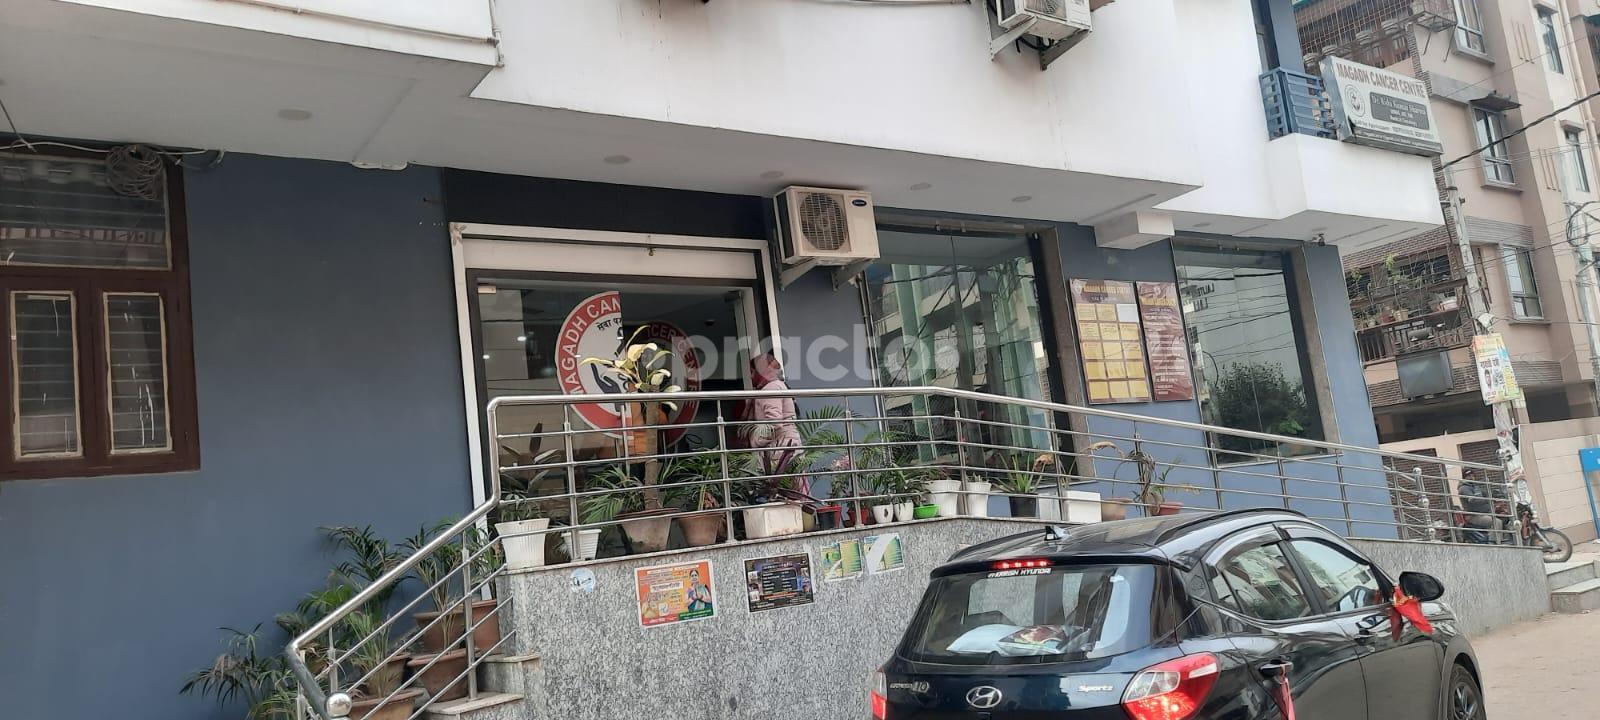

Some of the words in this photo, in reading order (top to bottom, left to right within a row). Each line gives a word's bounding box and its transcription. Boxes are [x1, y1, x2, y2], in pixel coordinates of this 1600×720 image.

[1336, 63, 1371, 84] MAGADH
[1370, 71, 1400, 92] CANCER
[1400, 79, 1427, 98] CENTRE
